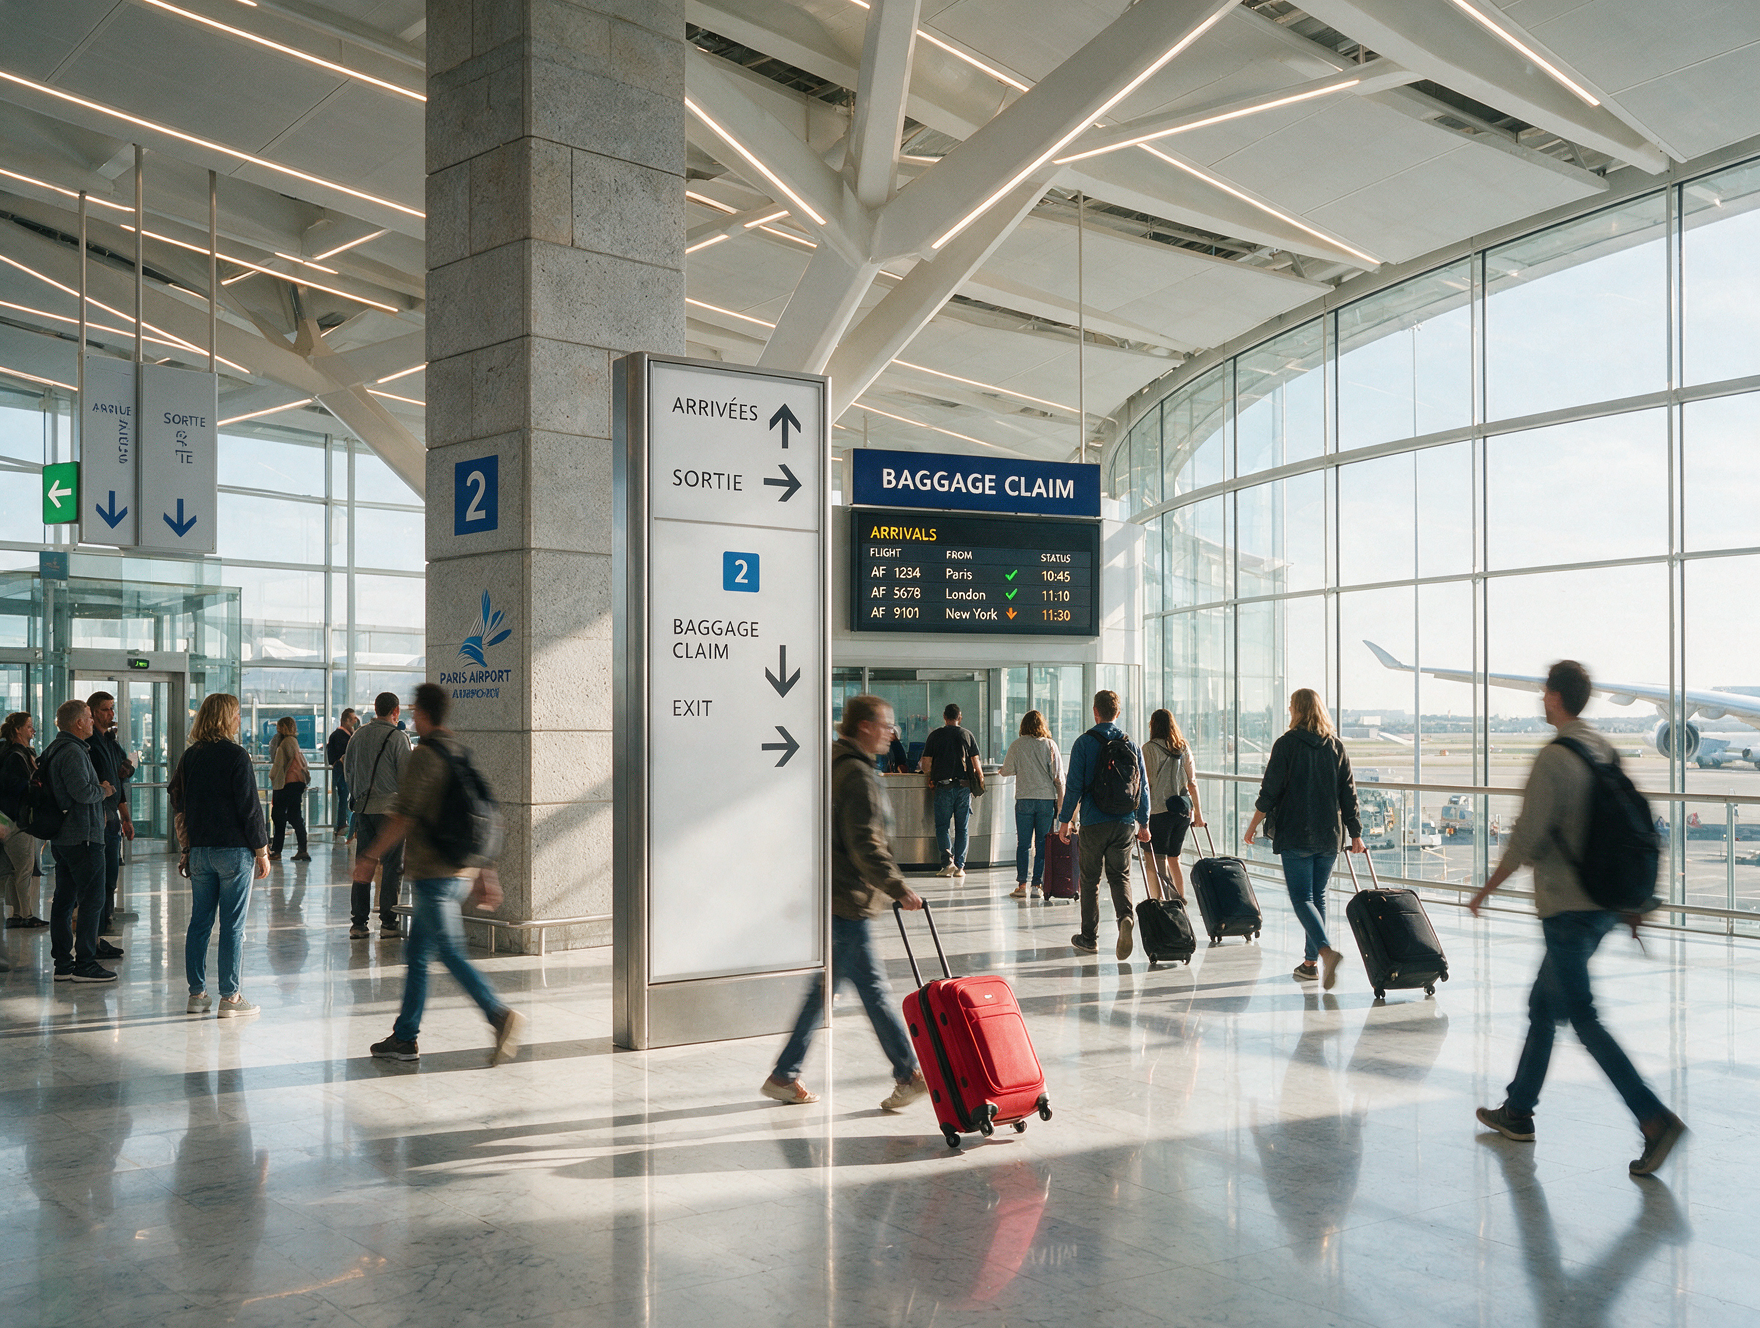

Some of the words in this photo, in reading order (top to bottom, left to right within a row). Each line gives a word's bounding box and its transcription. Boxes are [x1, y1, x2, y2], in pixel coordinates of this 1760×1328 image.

[672, 397, 758, 421] ARRIVÉES
[672, 469, 743, 491] SORTIE
[882, 468, 997, 495] BAGGAGE
[1004, 476, 1075, 499] CLAIM
[465, 470, 486, 522] 2
[870, 525, 937, 542] ARRIVALS
[870, 547, 902, 558] FLIGHT
[946, 550, 973, 560] FROM
[1040, 553, 1071, 563] STATUS
[734, 559, 749, 584] 2
[870, 566, 887, 578] AF
[893, 566, 921, 579] 1234
[945, 567, 973, 580] Paris
[1041, 570, 1071, 583] 10:45
[870, 586, 887, 599] AF
[893, 587, 921, 599] 5678
[945, 588, 986, 600] London
[1041, 590, 1070, 602] 11:10
[870, 606, 886, 618] AF
[893, 606, 920, 619] 9101
[945, 608, 971, 620] New
[972, 608, 998, 621] York
[1041, 609, 1071, 622] 11:30
[673, 618, 759, 638] BAGGAGE
[672, 642, 729, 660] CLAIM
[440, 671, 467, 684] PARIS
[469, 669, 512, 683] AIRPORT
[673, 700, 713, 717] EXIT
